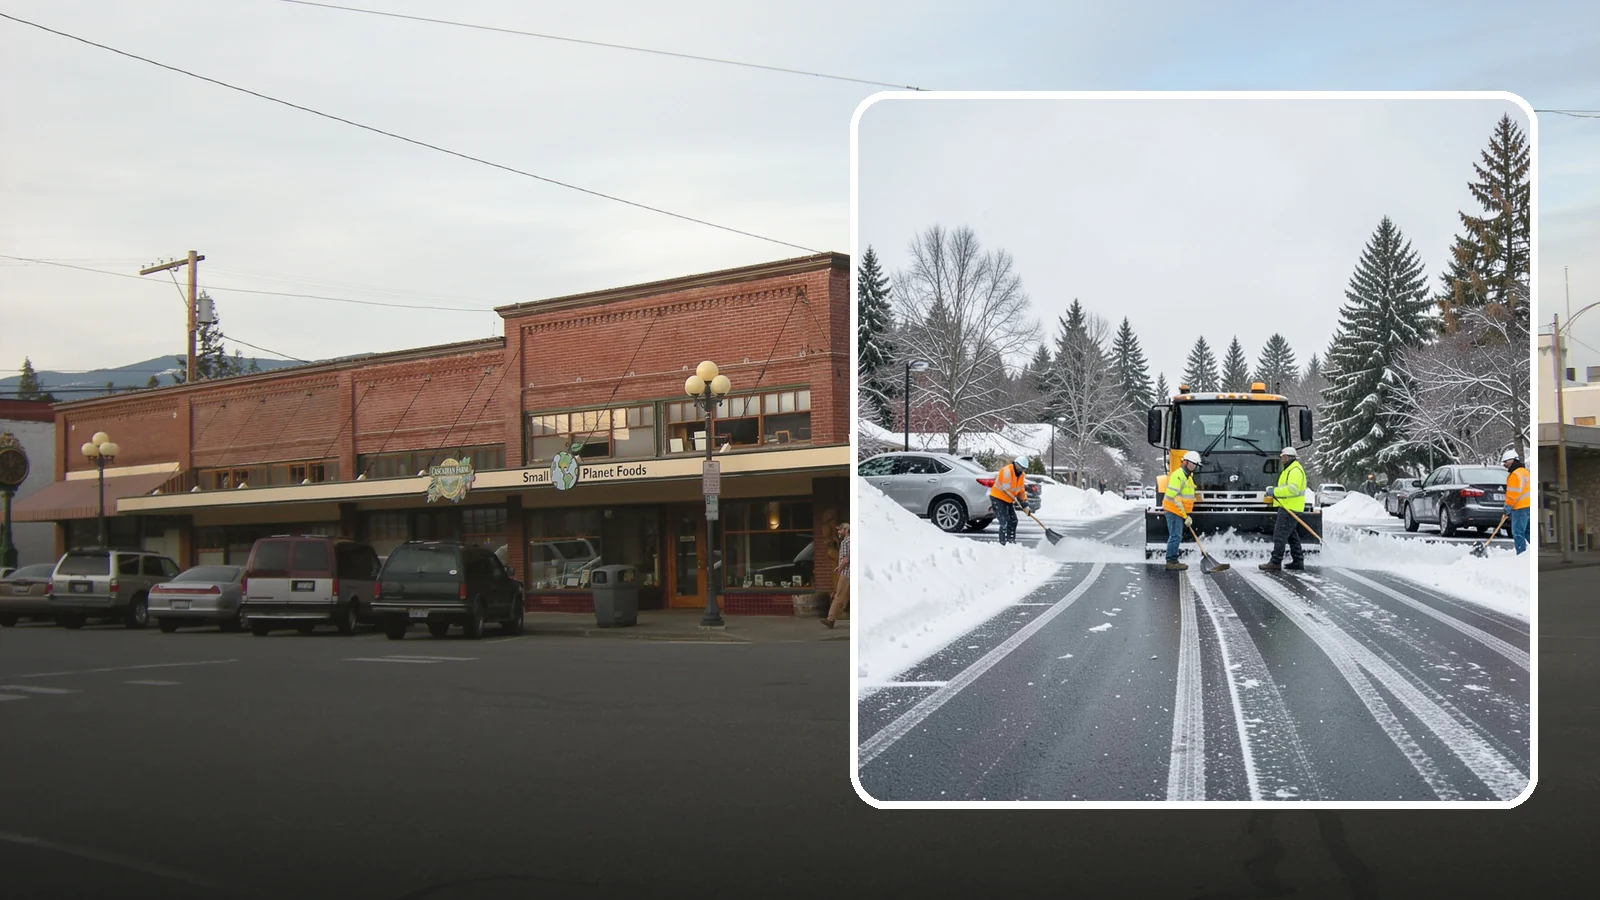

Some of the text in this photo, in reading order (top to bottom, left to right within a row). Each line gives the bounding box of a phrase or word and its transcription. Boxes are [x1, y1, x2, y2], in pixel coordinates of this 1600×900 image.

[523, 464, 647, 483] Small Planet Foods
